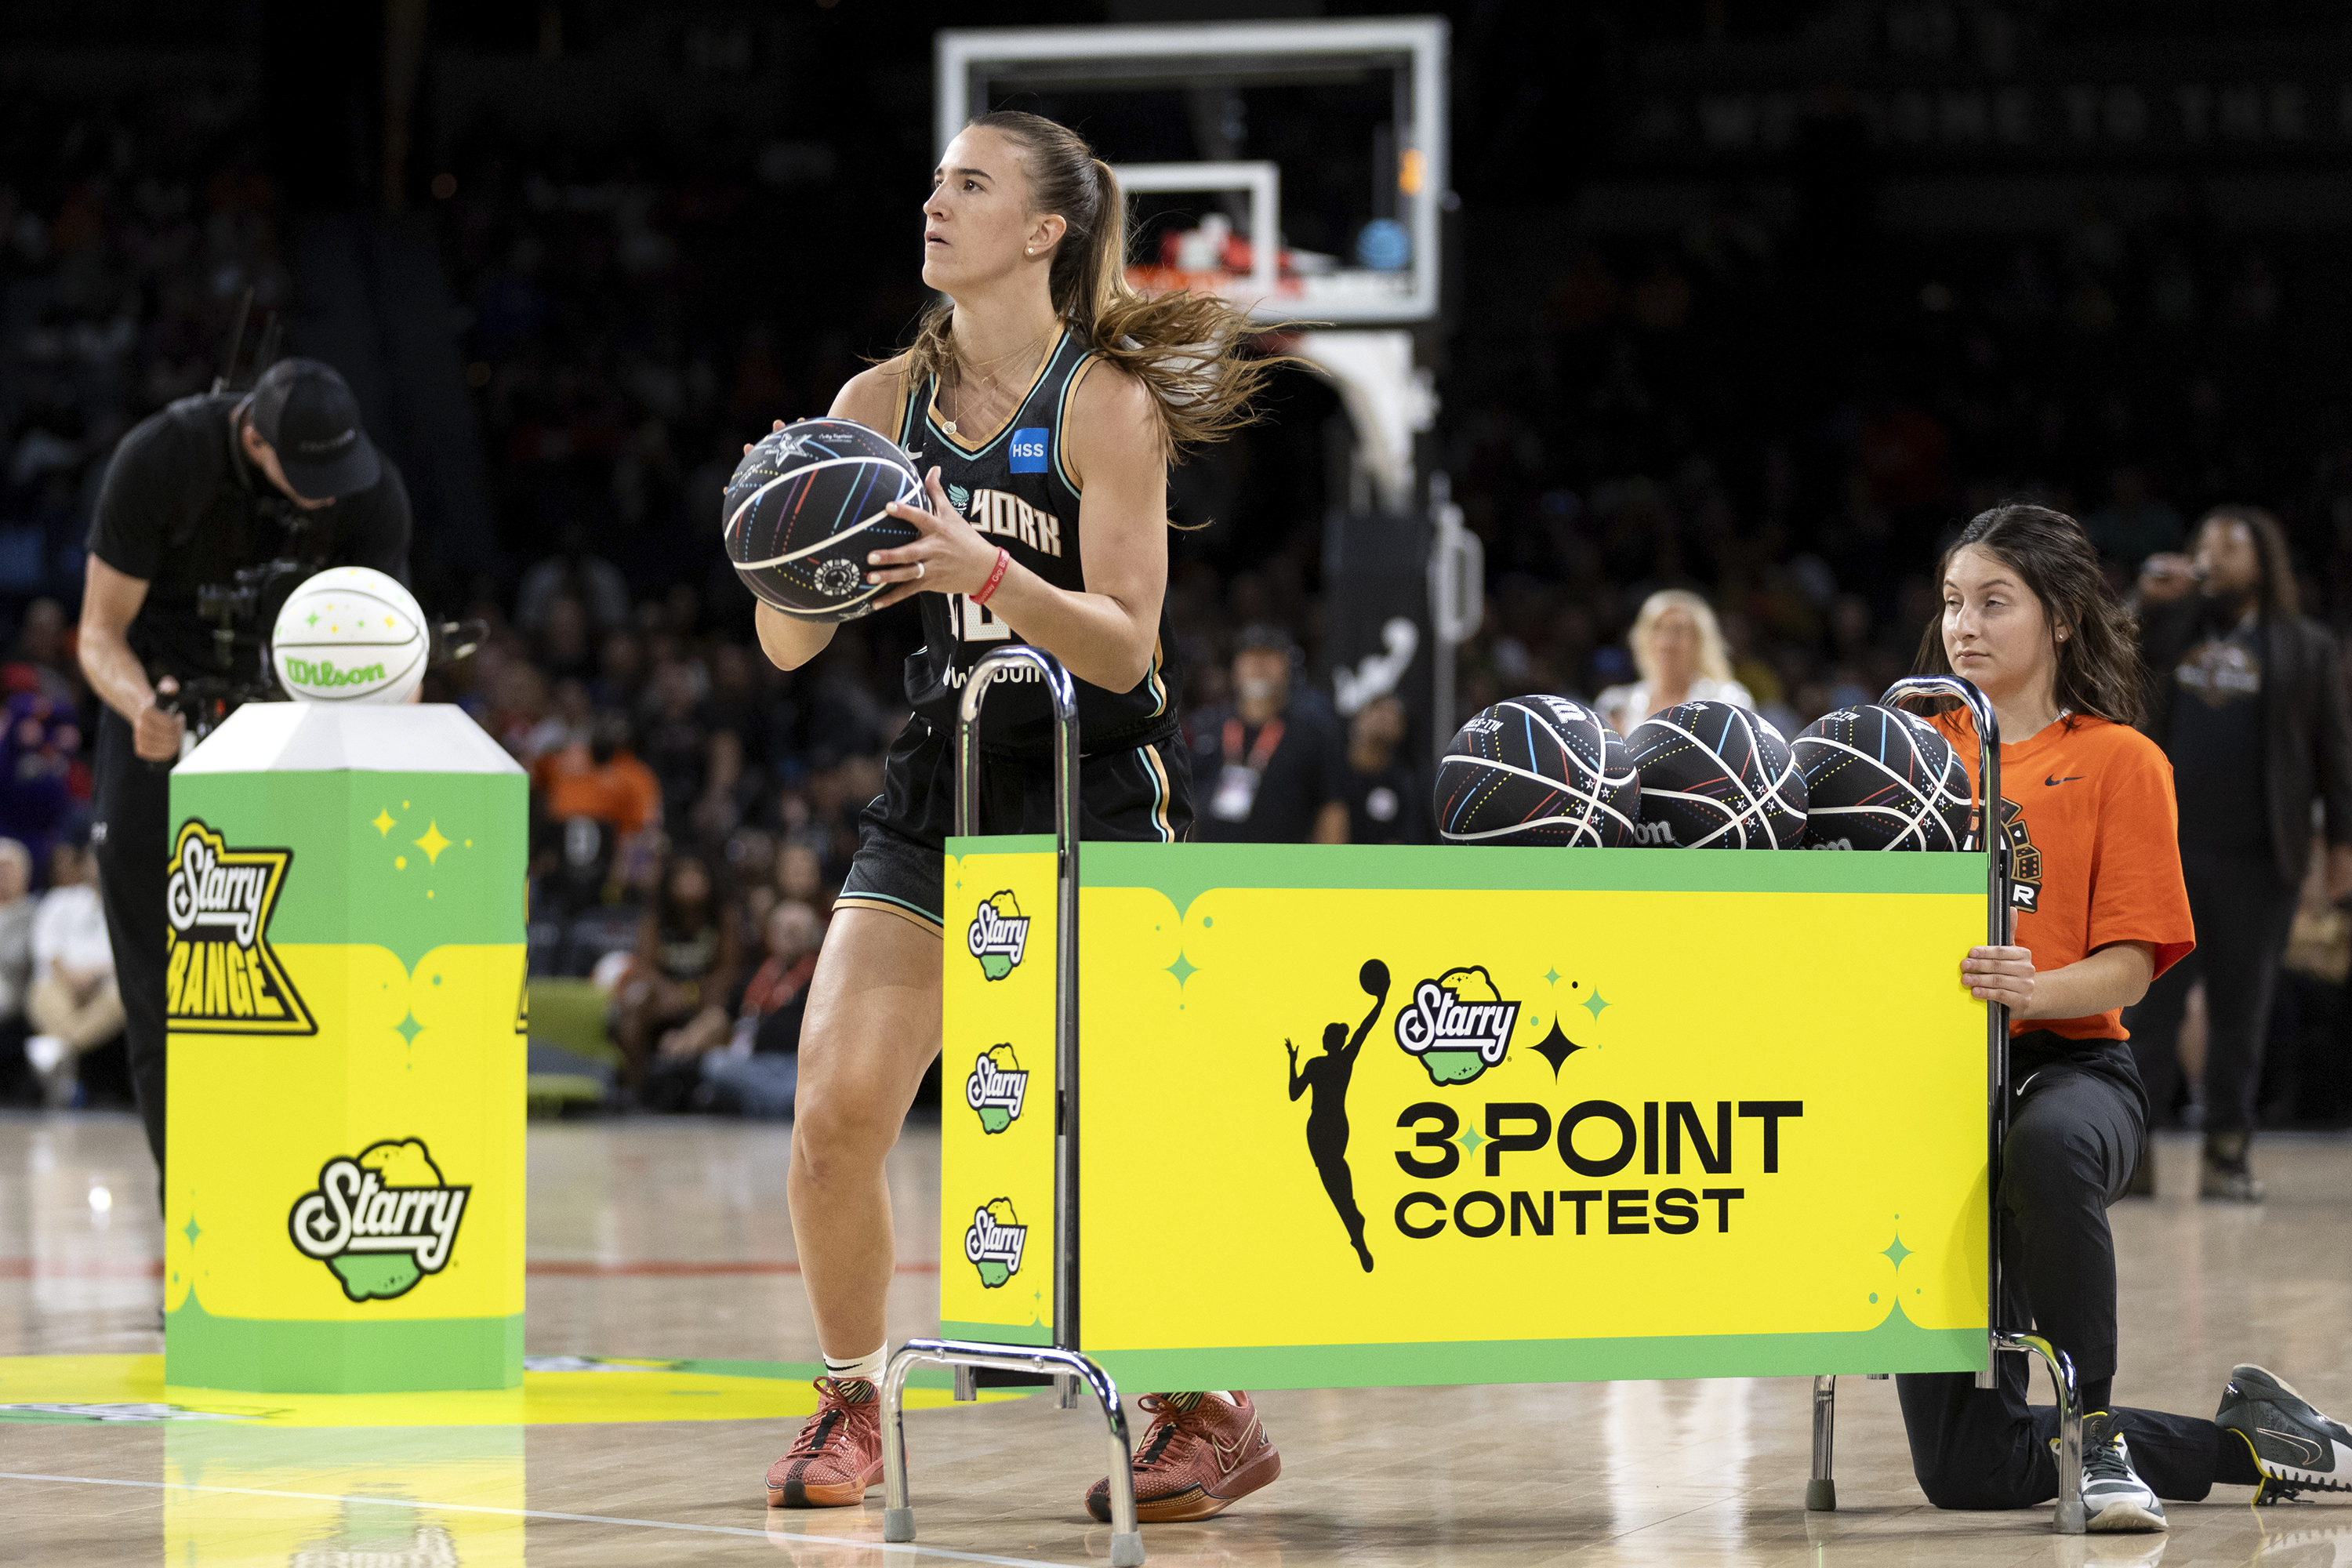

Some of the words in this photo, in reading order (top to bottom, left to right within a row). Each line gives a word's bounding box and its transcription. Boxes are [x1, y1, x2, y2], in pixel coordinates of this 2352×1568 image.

[1011, 443, 1045, 458] HSS
[969, 488, 1062, 558] YORK
[285, 657, 386, 687] Wilson
[167, 837, 267, 947] Starry
[968, 902, 1029, 964] Starry
[167, 941, 285, 1017] RANGE
[1399, 984, 1515, 1063] Starry
[967, 1055, 1027, 1118] Starry
[294, 1162, 464, 1270] Starry
[965, 1209, 1025, 1272] Starry
[1394, 1188, 1745, 1240] CONTEST
